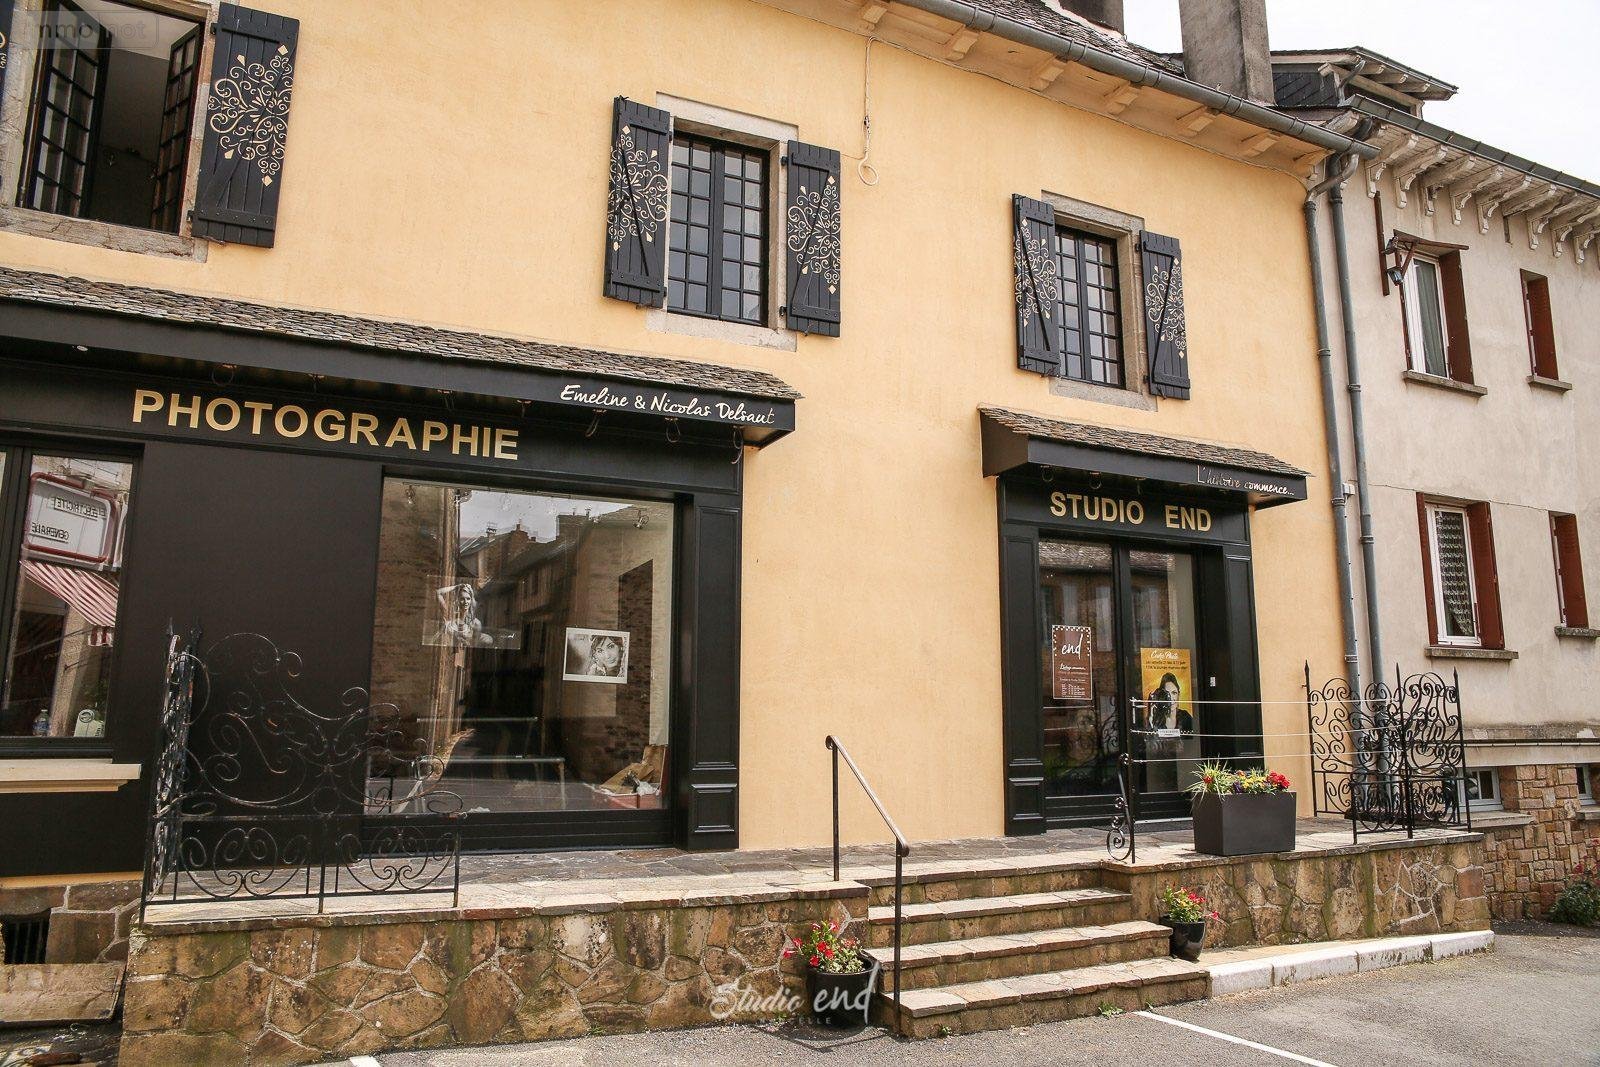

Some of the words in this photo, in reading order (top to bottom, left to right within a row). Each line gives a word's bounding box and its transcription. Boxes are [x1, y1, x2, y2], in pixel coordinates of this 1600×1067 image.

[132, 389, 519, 460] PHOTOGRAPHIE
[560, 384, 629, 408] Emeline
[634, 395, 646, 410] &
[650, 392, 712, 417] Nicolas
[715, 402, 775, 425] Delsaut
[1050, 491, 1144, 525] STUDIO
[1164, 504, 1212, 532] END
[1061, 633, 1083, 660] end
